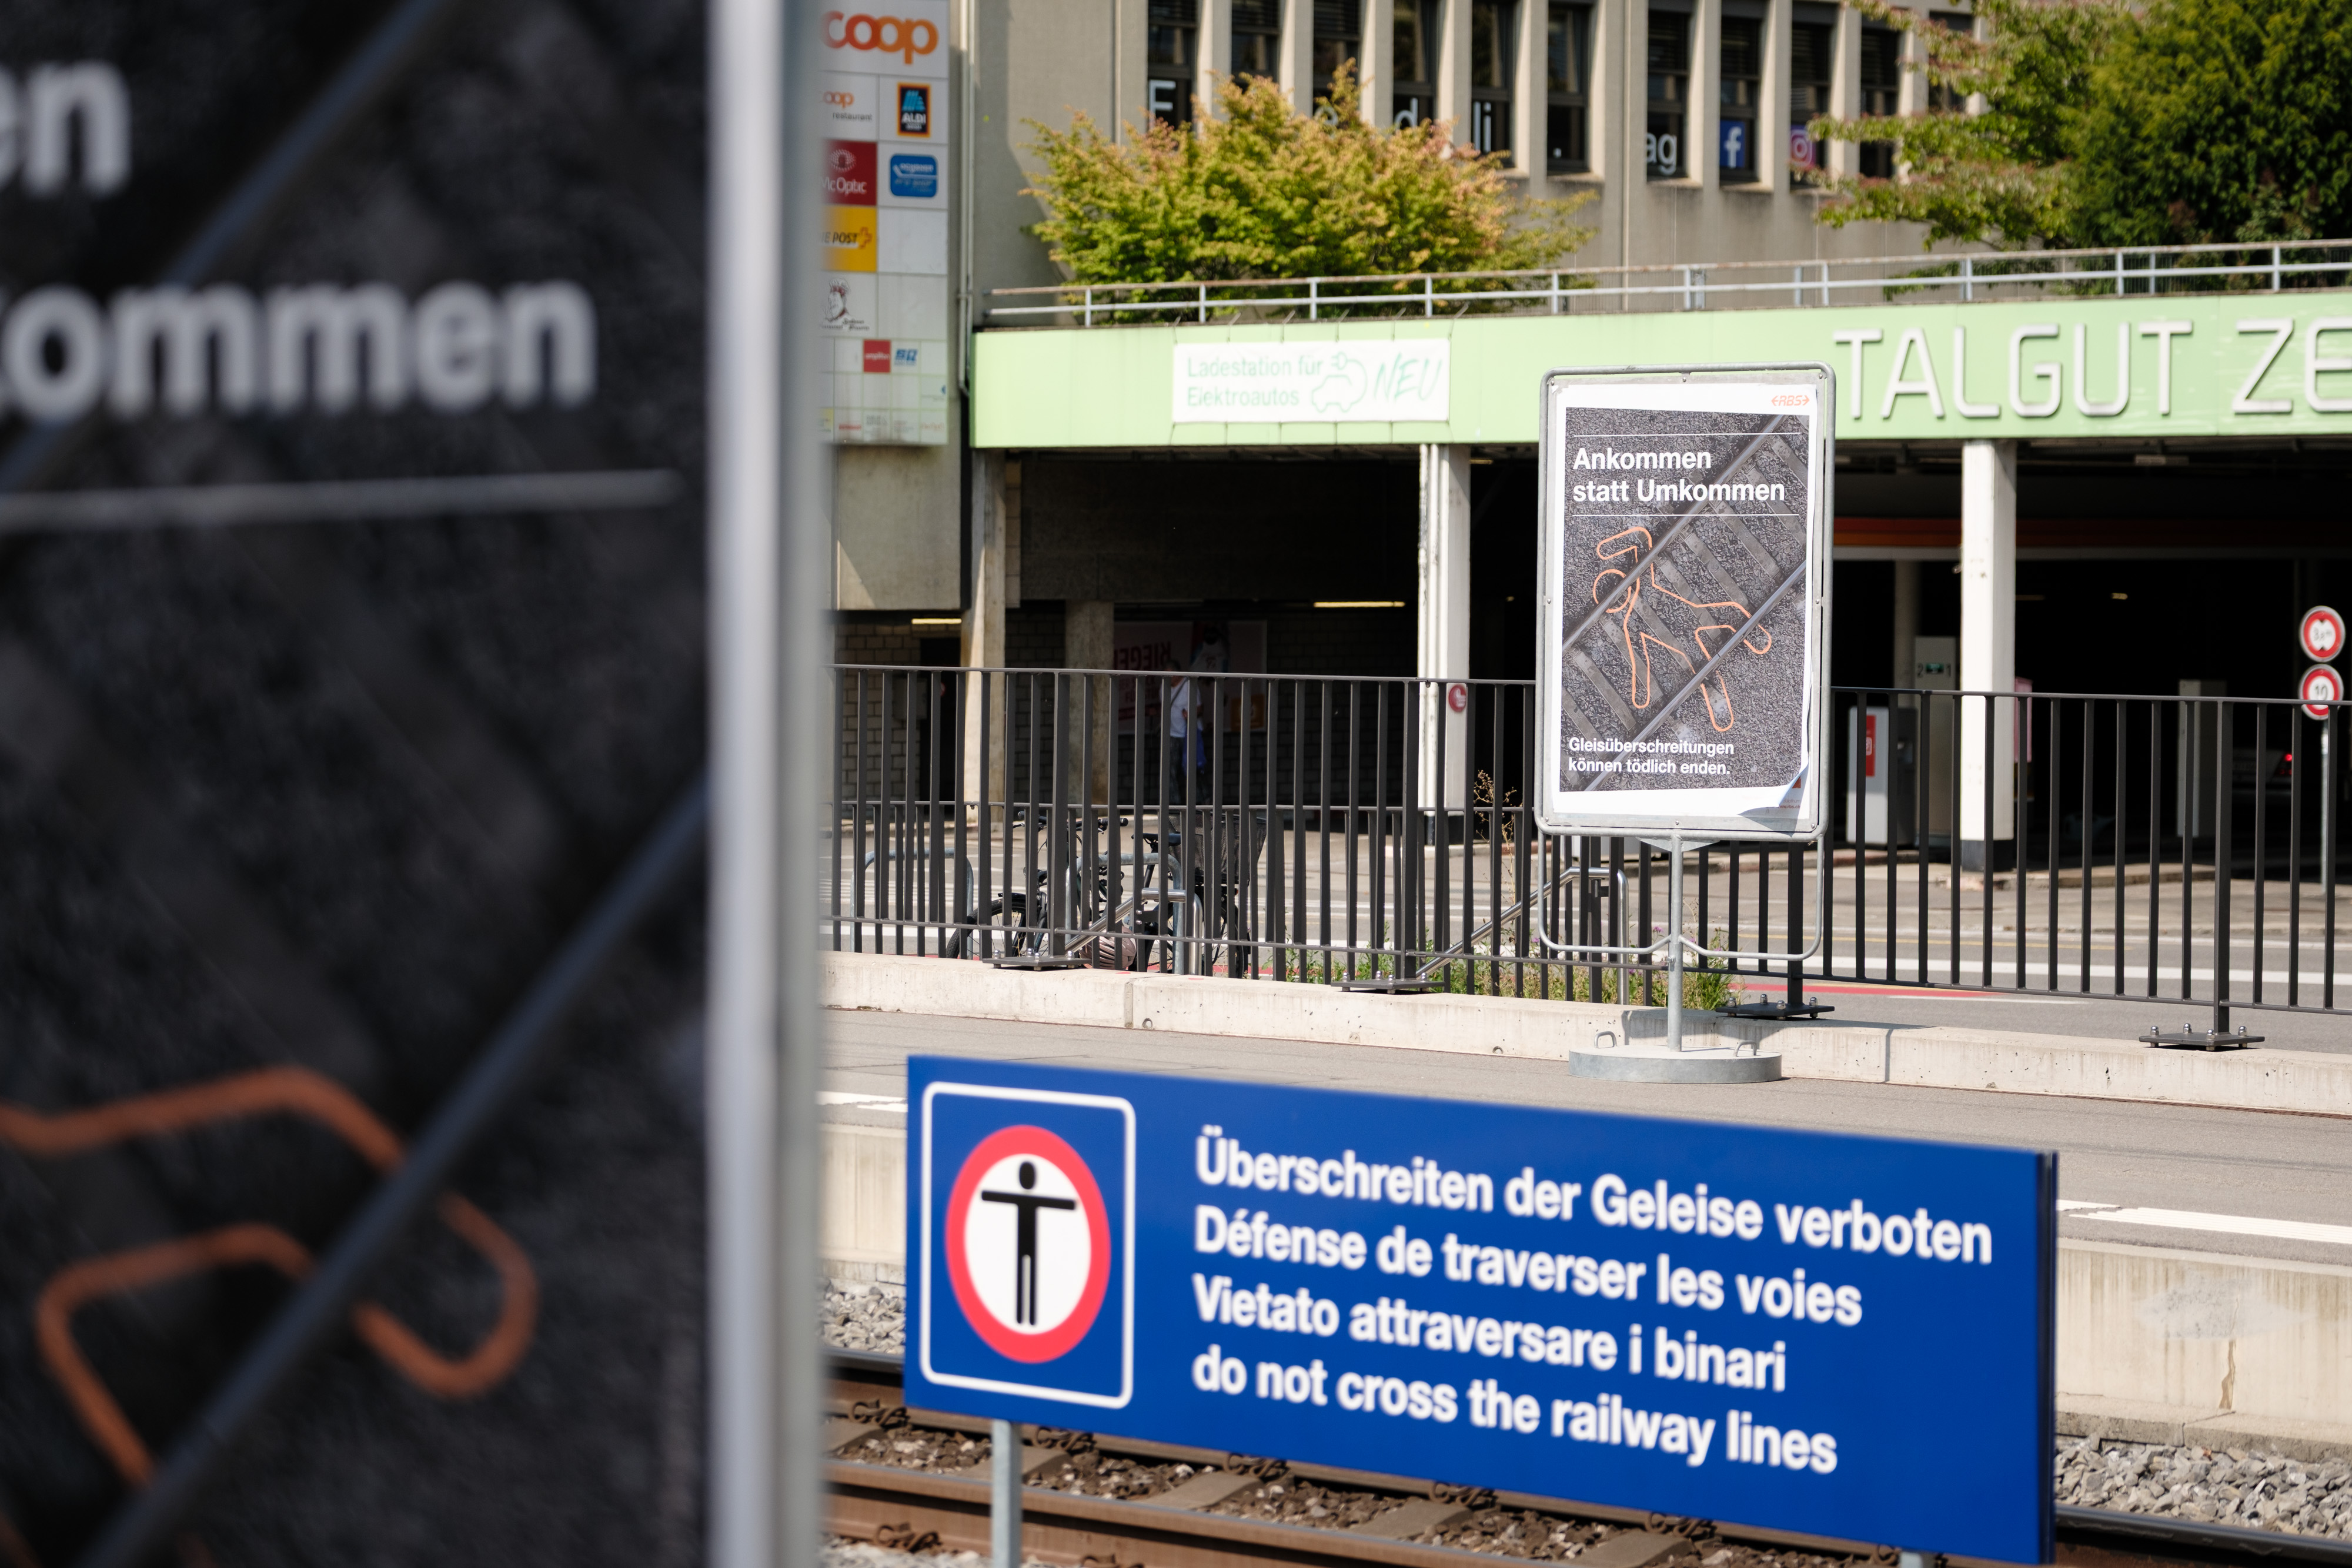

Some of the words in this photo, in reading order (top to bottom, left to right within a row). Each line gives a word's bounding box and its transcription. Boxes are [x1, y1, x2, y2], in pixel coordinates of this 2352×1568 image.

[821, 11, 939, 65] coop
[901, 112, 927, 124] ALDI
[833, 232, 859, 244] POST
[0, 280, 597, 422] ommen
[1832, 319, 2193, 419] TALGUT
[2231, 317, 2352, 414] ZE
[1188, 356, 1292, 377] Ladestation
[1298, 356, 1324, 376] für
[1373, 352, 1442, 402] NEU
[1188, 386, 1299, 407] Elektroautos
[1778, 394, 1803, 406] RBS
[1573, 447, 1712, 470] Ankommen
[1572, 481, 1629, 503] statt
[1637, 479, 1785, 502] Umkommen
[1568, 737, 1735, 755] Gleisüberschreitungen
[1568, 757, 1622, 773] können
[1626, 758, 1677, 774] tödlich
[1681, 760, 1730, 775] enden.
[1196, 1125, 1494, 1212] Überschreiten
[1505, 1167, 1582, 1220] der
[1592, 1174, 1763, 1240] Geleise
[1775, 1199, 1992, 1264] verboten
[1195, 1205, 1367, 1269] Défense
[1377, 1225, 1433, 1277] de
[1441, 1233, 1646, 1300] traverser
[1657, 1253, 1725, 1310] les
[1736, 1268, 1862, 1326] voies
[1192, 1273, 1339, 1336] Vietato
[1349, 1297, 1618, 1370] attraversare
[1629, 1323, 1642, 1373] i
[1655, 1326, 1786, 1392] binari
[1192, 1344, 1247, 1395] do
[1257, 1359, 1328, 1406] not
[1337, 1372, 1458, 1422] cross
[1467, 1379, 1541, 1433] the
[1552, 1393, 1716, 1466] railway
[1726, 1409, 1838, 1473] lines
